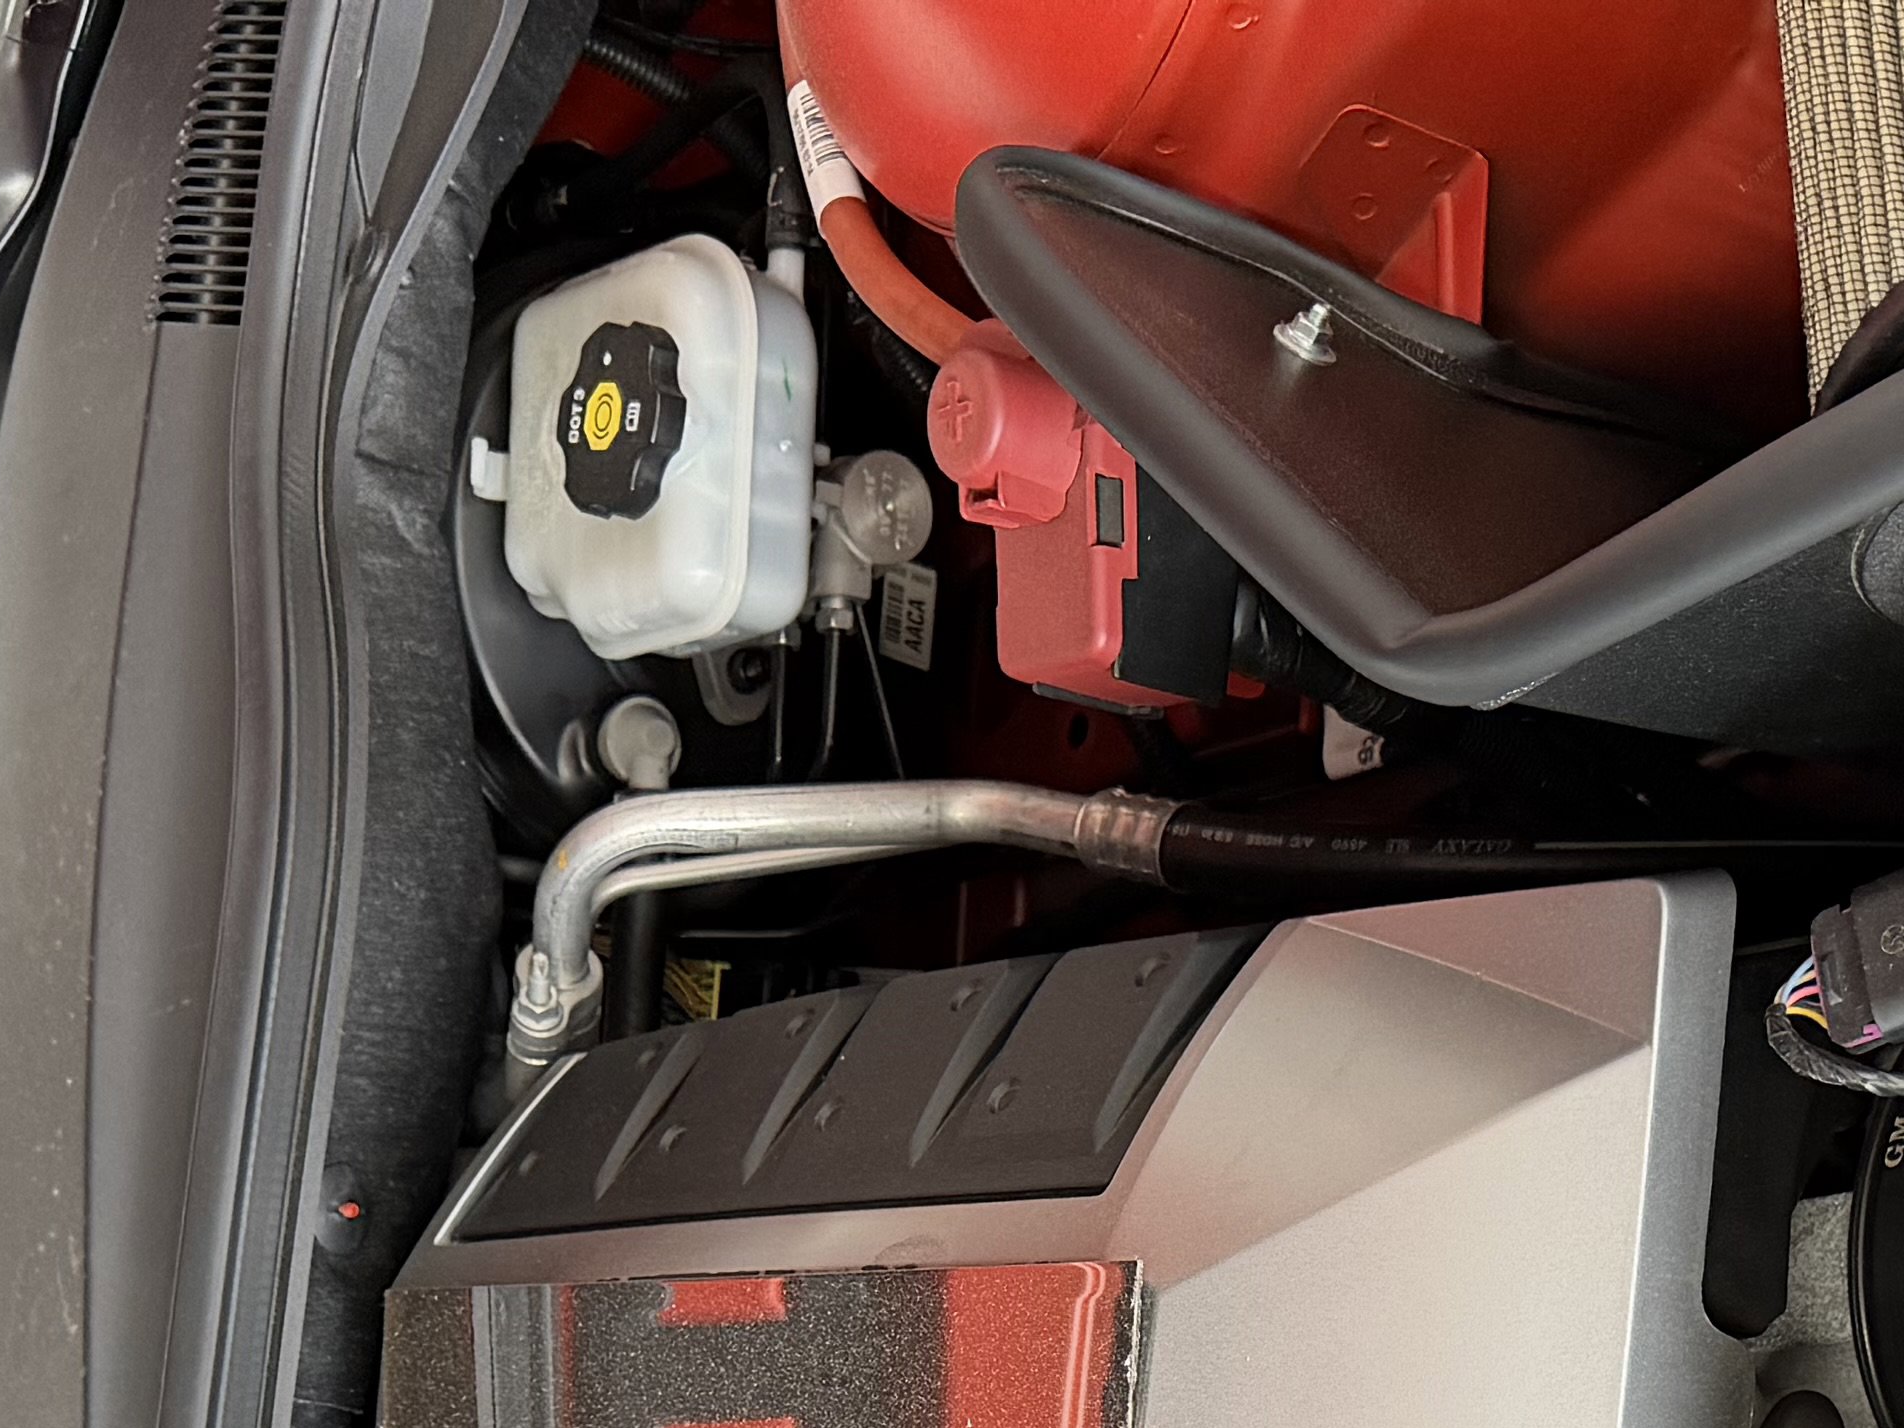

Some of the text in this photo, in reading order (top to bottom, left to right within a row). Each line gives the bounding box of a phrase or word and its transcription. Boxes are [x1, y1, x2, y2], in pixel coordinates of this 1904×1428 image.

[567, 385, 586, 444] DOT 3
[904, 597, 926, 655] AACA
